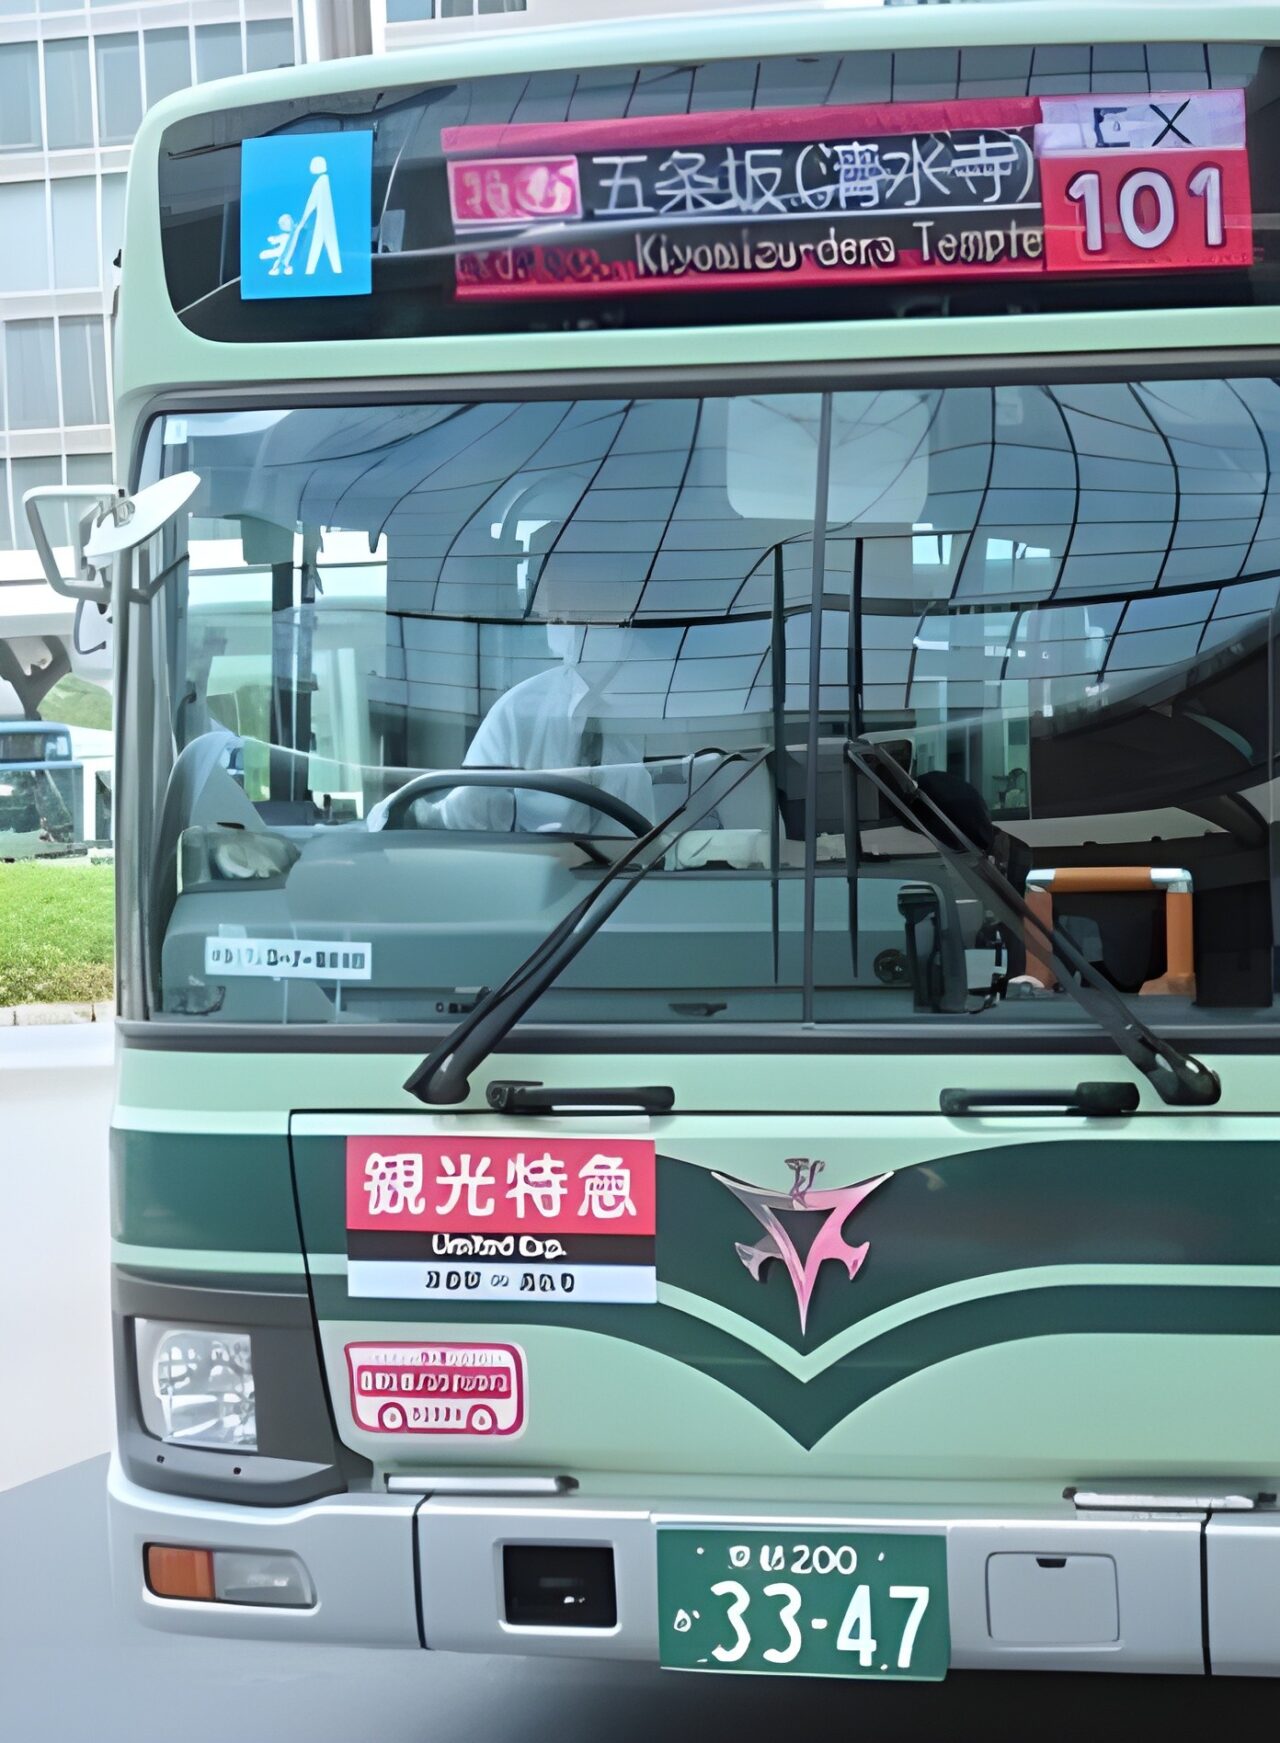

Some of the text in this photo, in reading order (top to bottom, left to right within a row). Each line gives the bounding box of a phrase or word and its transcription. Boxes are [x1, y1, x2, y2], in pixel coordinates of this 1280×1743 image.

[1092, 98, 1194, 149] EX
[1066, 163, 1225, 252] 101
[363, 1151, 638, 1219] 観光特急
[710, 1579, 930, 1669] 33-47
